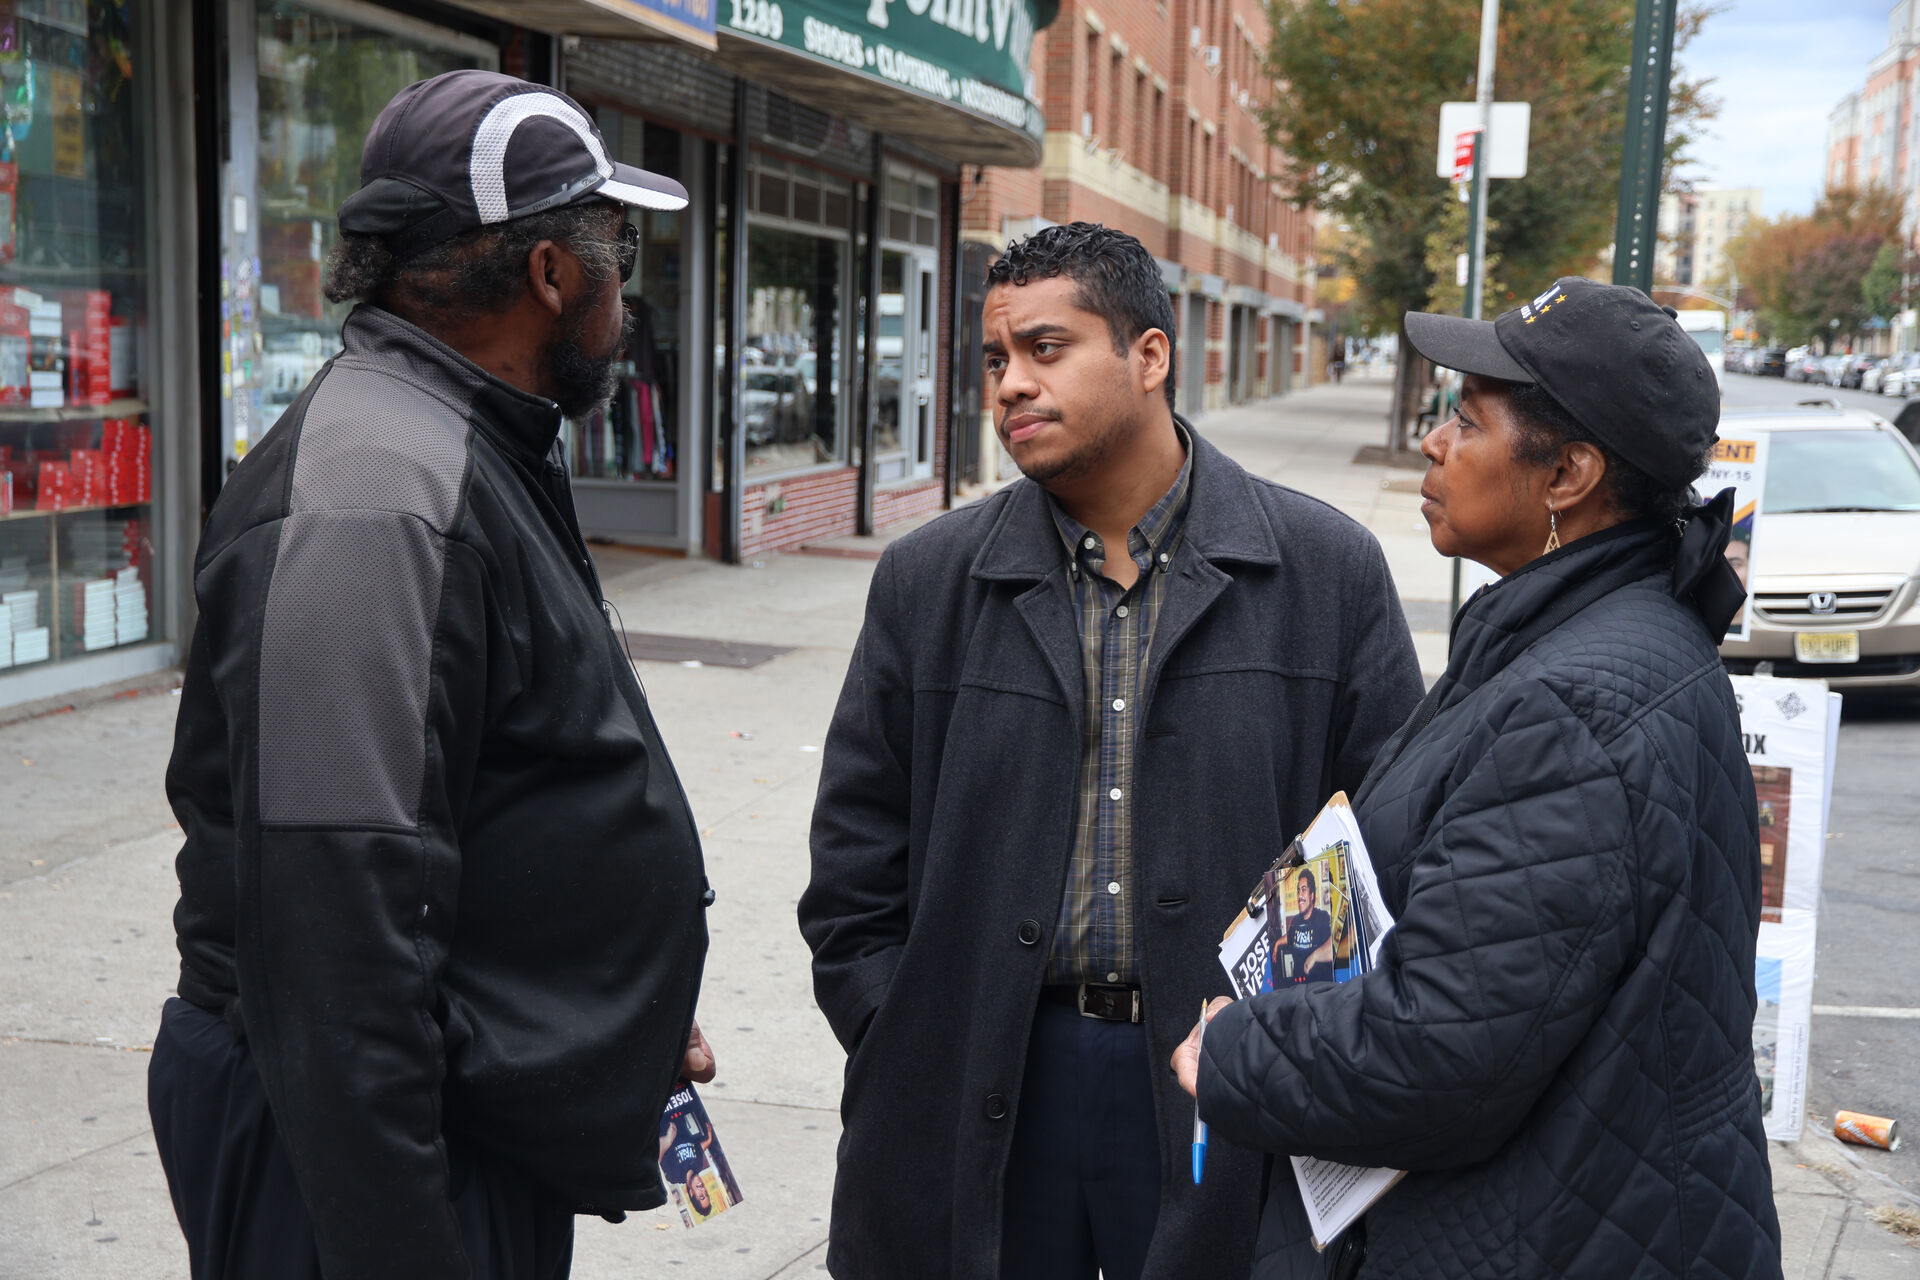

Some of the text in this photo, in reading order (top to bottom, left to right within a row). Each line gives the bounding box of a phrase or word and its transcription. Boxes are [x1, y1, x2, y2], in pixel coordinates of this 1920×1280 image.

[729, 0, 783, 40] 1289
[803, 16, 865, 68] SHOES
[876, 43, 952, 100] CLOTHING
[1239, 931, 1270, 983] JOSE
[670, 1088, 693, 1108] JOSE
